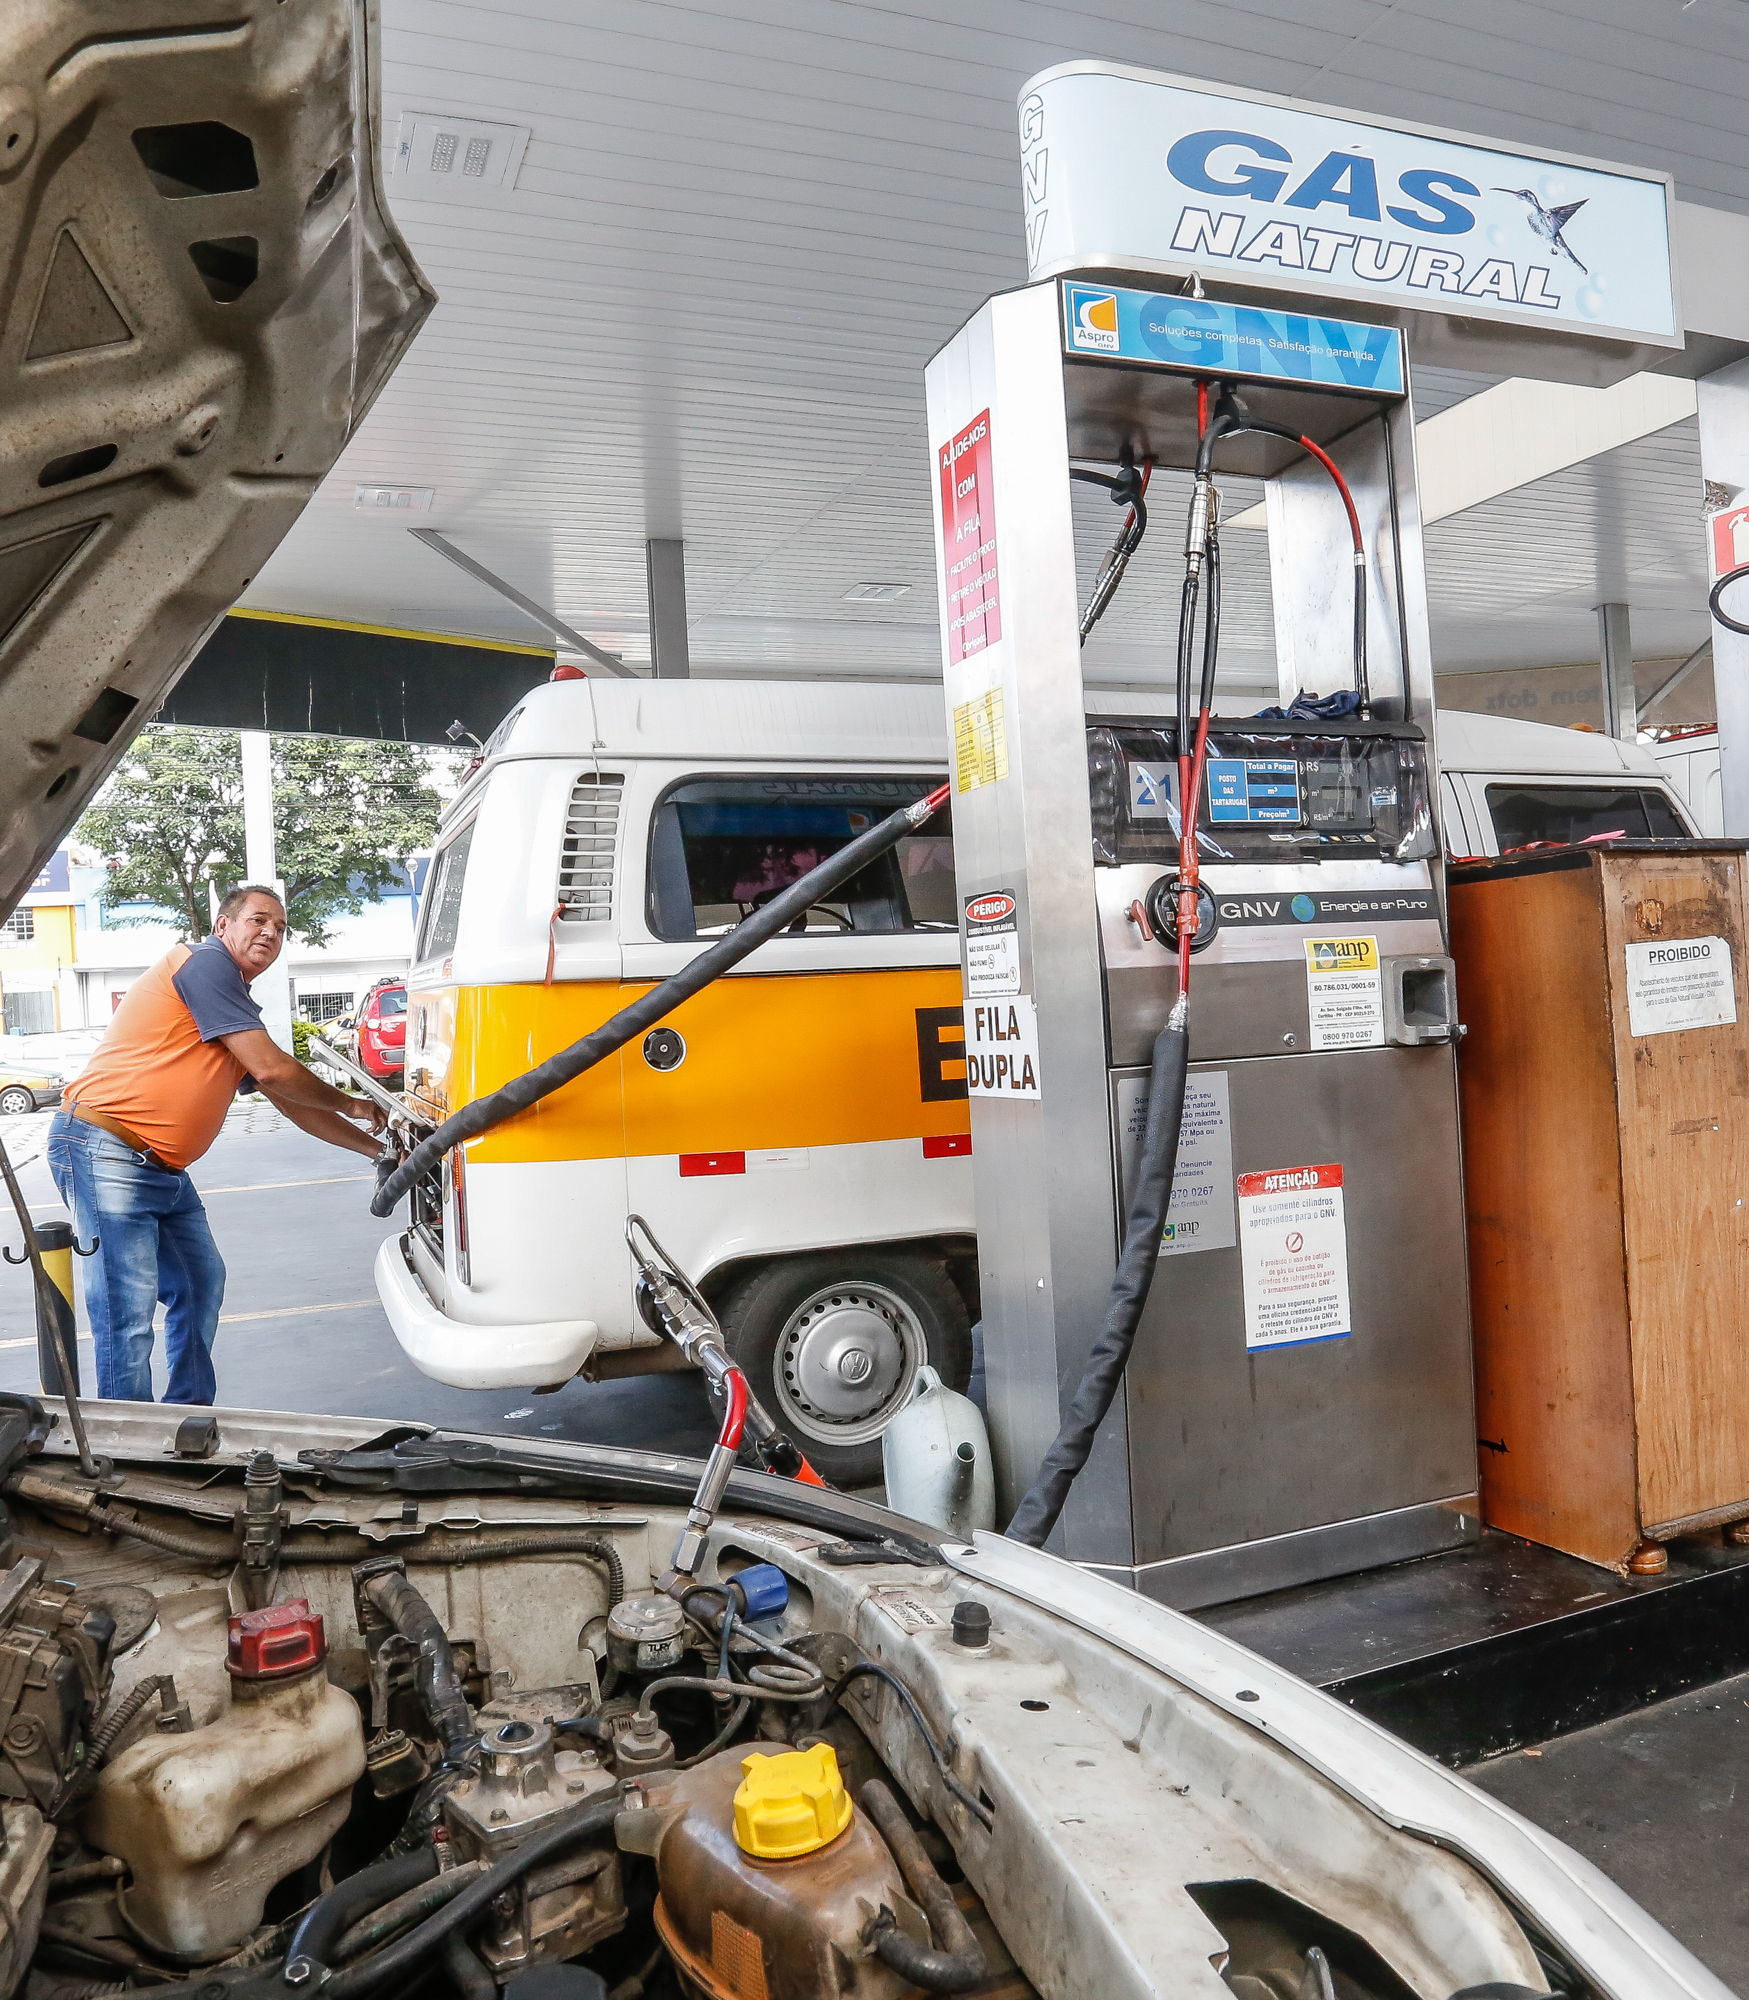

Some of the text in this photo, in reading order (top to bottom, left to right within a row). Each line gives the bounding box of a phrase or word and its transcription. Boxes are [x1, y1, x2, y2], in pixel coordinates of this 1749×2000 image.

[1166, 129, 1482, 235] GÁS
[1169, 206, 1562, 310] NATURAL
[1078, 329, 1115, 344] Aspro
[1149, 322, 1377, 362] Soluções completas. Satisfação garantida.
[942, 419, 987, 470] AJUDE-NOS
[957, 472, 977, 499] COM
[956, 512, 981, 543] A FILA
[950, 539, 996, 578] FACILITE O TROCO
[951, 584, 970, 605] RETIRE
[969, 582, 975, 593] O
[1247, 762, 1266, 770] Total
[1274, 763, 1294, 771] Pagar
[1306, 762, 1319, 772] R$
[1218, 775, 1237, 783] POSTO
[1136, 774, 1171, 805] 21
[1223, 787, 1234, 795] DAS
[1212, 798, 1247, 806] TARTARUGAS
[973, 900, 1007, 917] PERIGO
[1220, 898, 1428, 920] GNV Energia e ar Puro
[968, 922, 1015, 936] COMBUSTÍVEL INFLAMÁVEL
[969, 945, 977, 953] NÃO
[985, 943, 1000, 951] CELULAR
[1336, 941, 1370, 961] anp
[1648, 944, 1711, 963] PROIBIDO
[978, 973, 995, 981] PRODUZA
[975, 1006, 1021, 1042] FILA
[1356, 1030, 1372, 1038] 0267
[915, 1006, 968, 1102] E
[968, 1053, 1037, 1090] DUPLA
[1192, 1101, 1216, 1109] natural
[1195, 1109, 1221, 1117] máxima
[1127, 1125, 1137, 1133] de
[1189, 1128, 1205, 1137] Mpa
[1185, 1139, 1198, 1148] psi.
[1180, 1160, 1213, 1169] Denuncie
[1264, 1169, 1319, 1190] ATENÇÃO
[1191, 1186, 1214, 1196] 0267
[1181, 1199, 1208, 1208] Gratuita
[1252, 1197, 1333, 1214] Use somente cilindros
[1250, 1214, 1293, 1228] apropriados
[1295, 1211, 1312, 1223] para
[1320, 1208, 1337, 1219] GNV.
[1177, 1221, 1200, 1234] anp
[1265, 1258, 1287, 1267] proibido
[1277, 1267, 1287, 1276] gás
[1296, 1263, 1315, 1272] cozinha
[1258, 1276, 1281, 1286] cilindros
[1290, 1272, 1322, 1282] refrigeração
[1323, 1269, 1335, 1277] para
[1268, 1282, 1310, 1294] armazenamento
[1258, 1303, 1271, 1311] Para
[1318, 1294, 1338, 1304] procure
[1271, 1309, 1289, 1319] oficina
[1290, 1306, 1322, 1316] credenciada
[1327, 1302, 1339, 1311] faça
[1293, 1316, 1313, 1325] cilindro
[1321, 1311, 1333, 1320] GNV
[1255, 1330, 1269, 1338] cada
[1290, 1325, 1299, 1334] Ele
[648, 1641, 672, 1652] TURY
